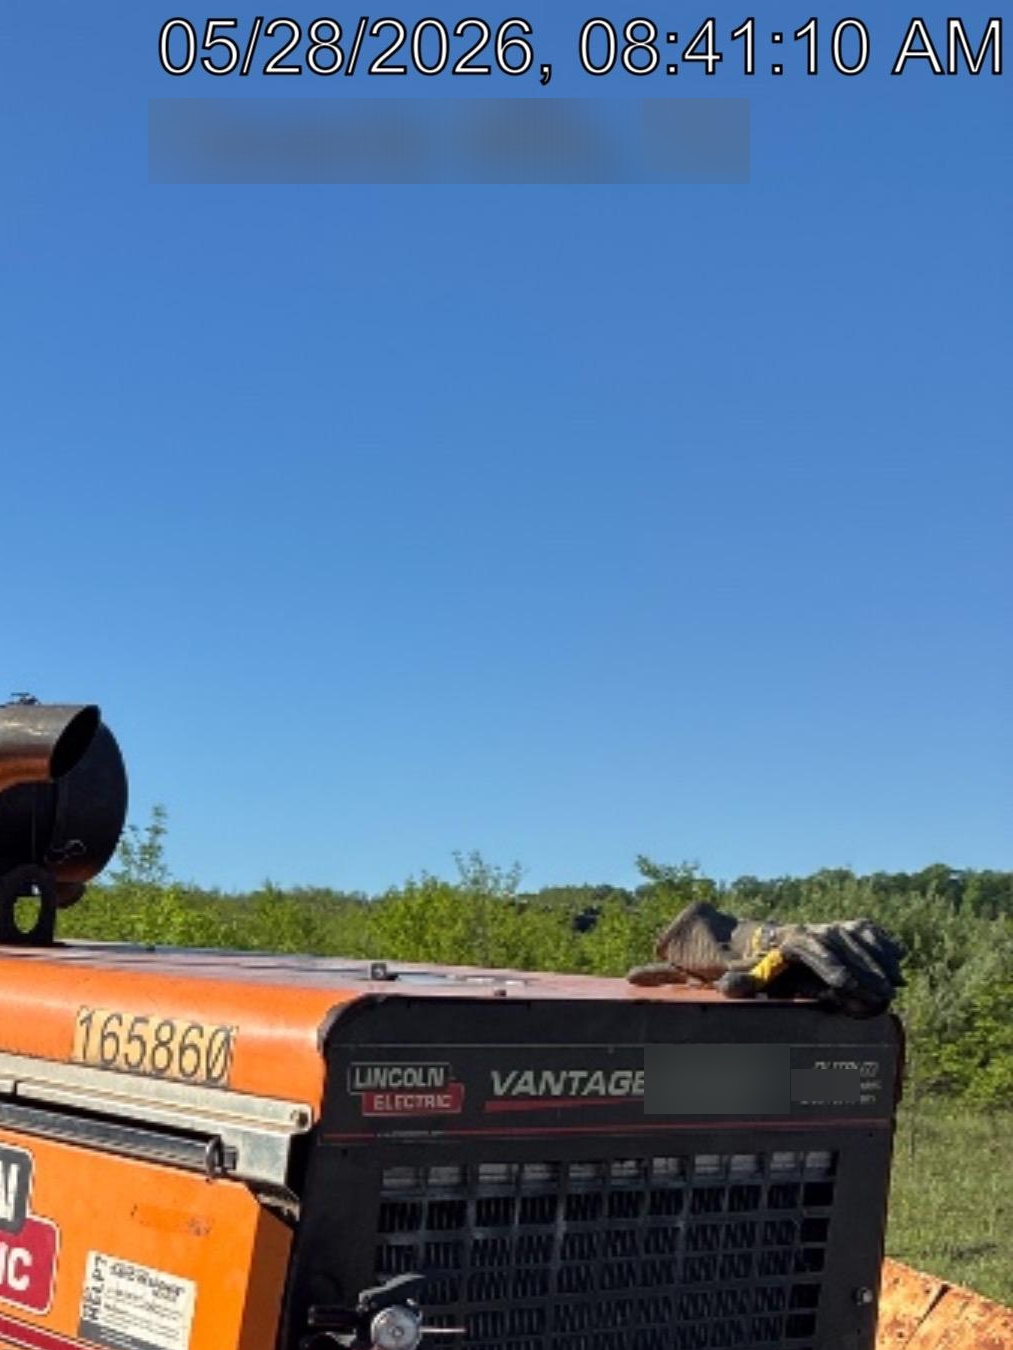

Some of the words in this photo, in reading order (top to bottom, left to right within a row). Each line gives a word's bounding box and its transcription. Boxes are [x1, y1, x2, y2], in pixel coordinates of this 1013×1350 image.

[79, 1010, 231, 1083] 165860
[354, 1067, 444, 1089] LINCOLN
[373, 1094, 452, 1111] ELECTRIC
